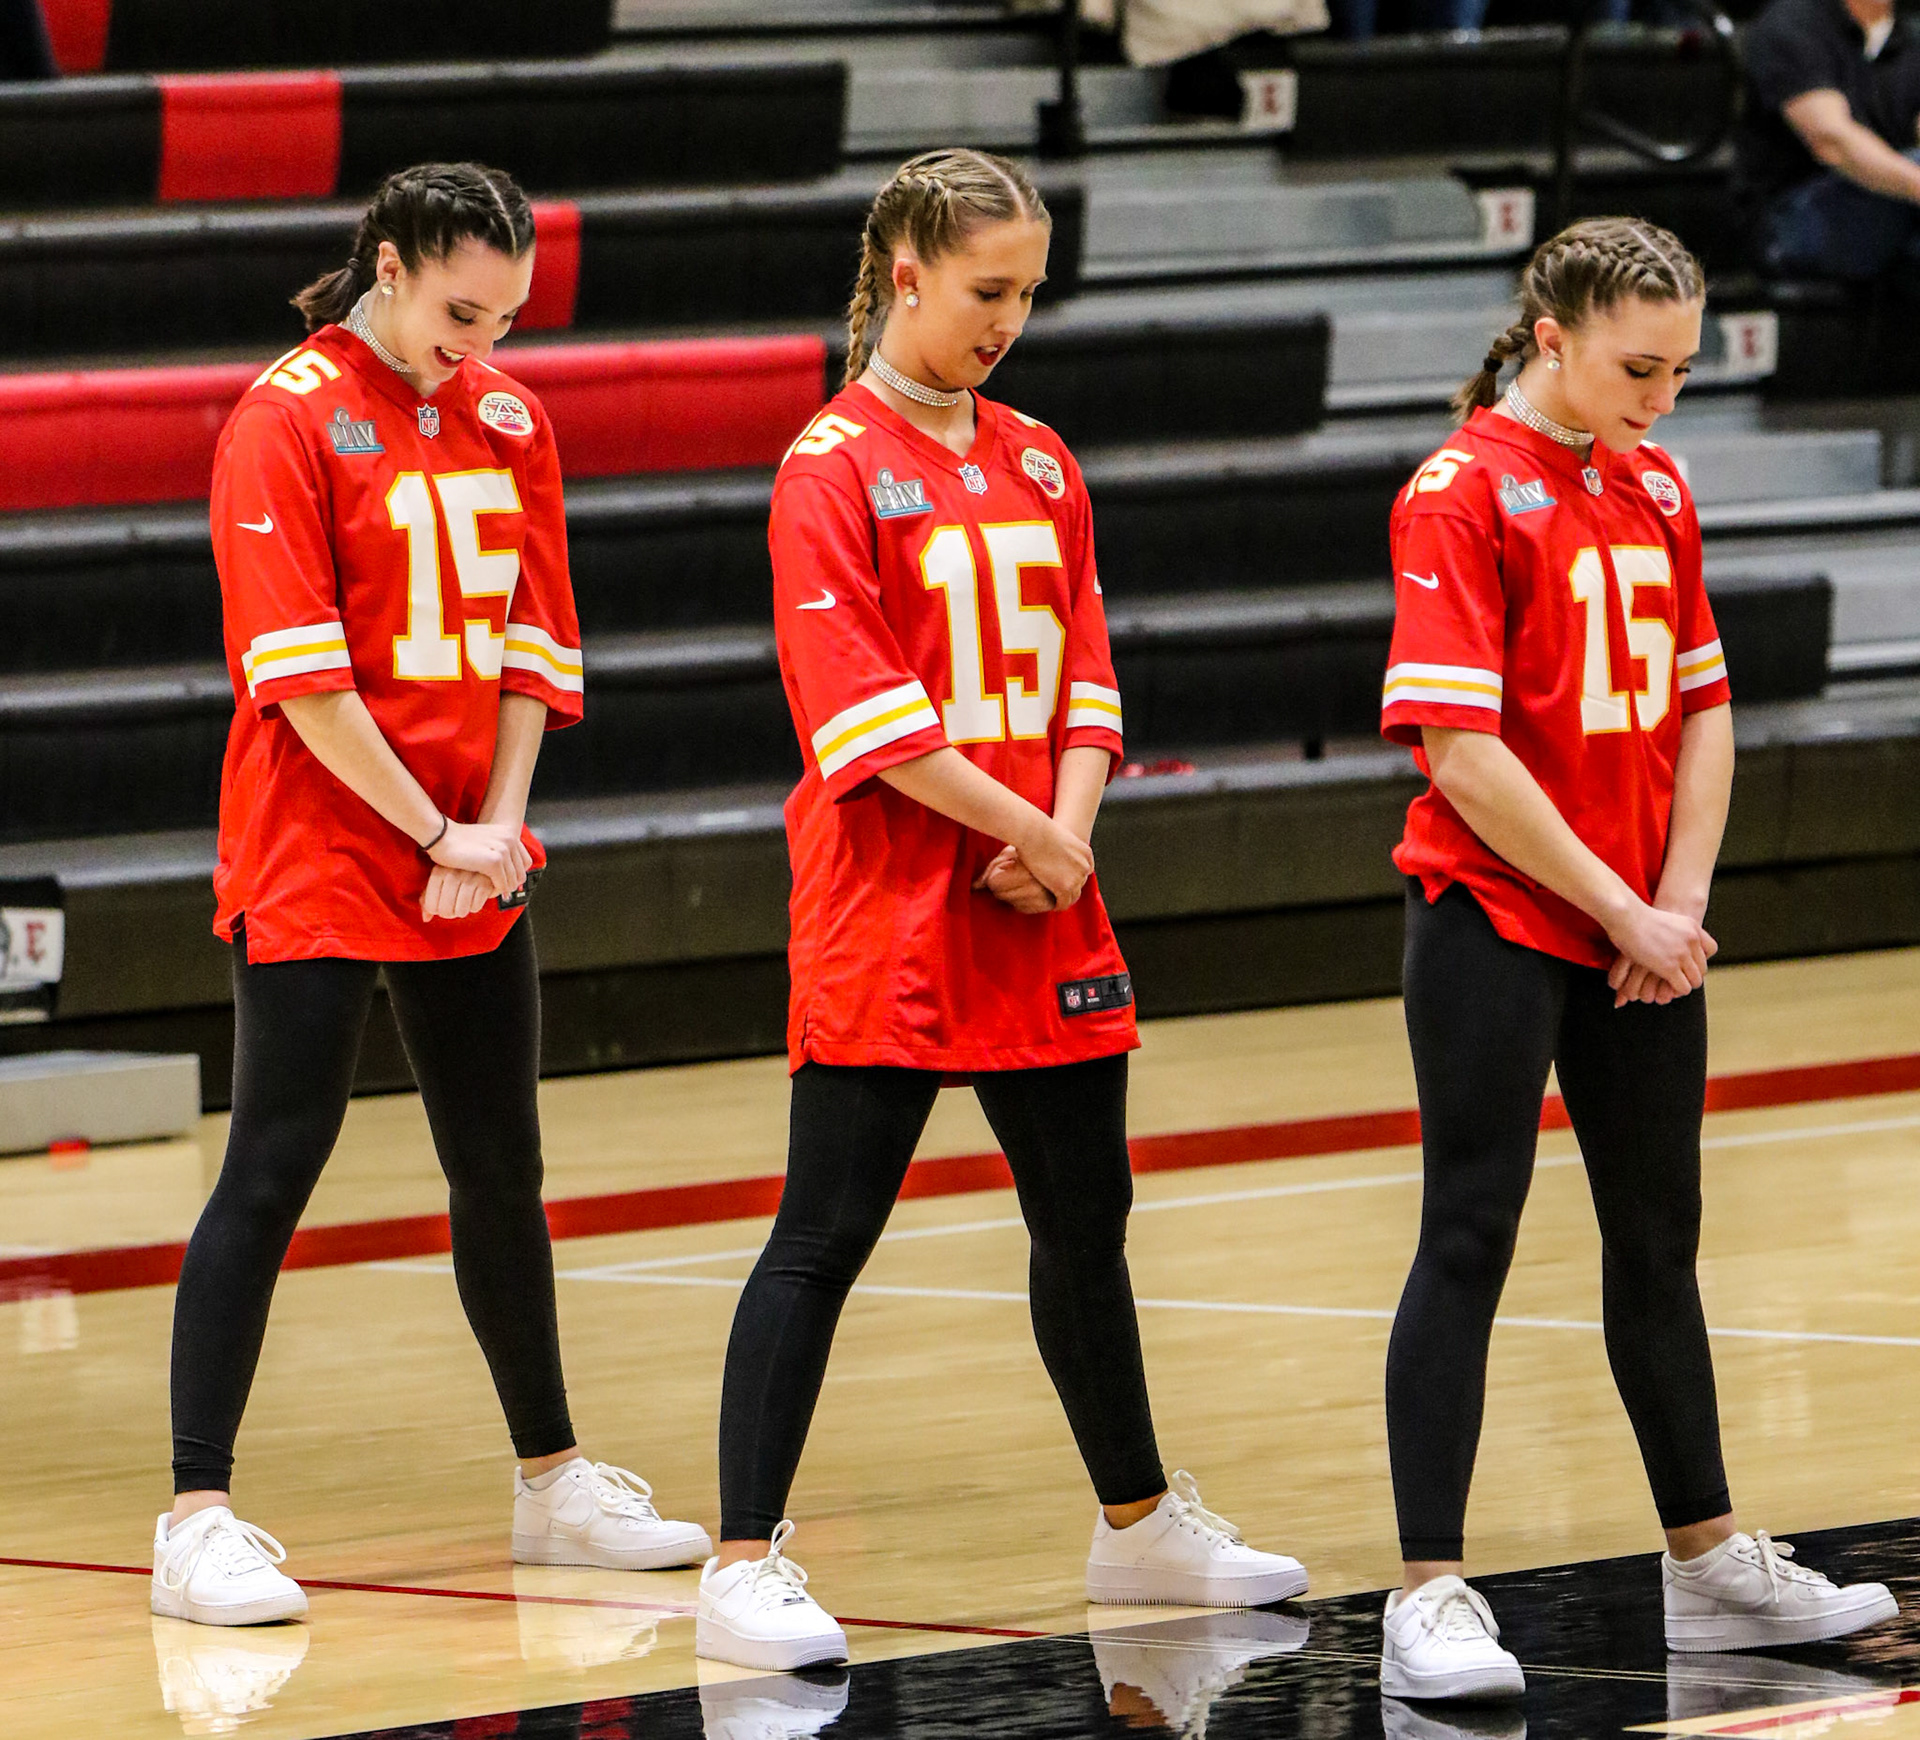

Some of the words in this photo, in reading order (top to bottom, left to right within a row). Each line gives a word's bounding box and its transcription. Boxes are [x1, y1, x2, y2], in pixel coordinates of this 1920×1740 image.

[422, 418, 438, 432] NFL
[780, 410, 867, 468] 5
[967, 475, 985, 491] NFL
[384, 467, 524, 681] 15
[918, 519, 1067, 746] 15
[1568, 544, 1676, 736] 15
